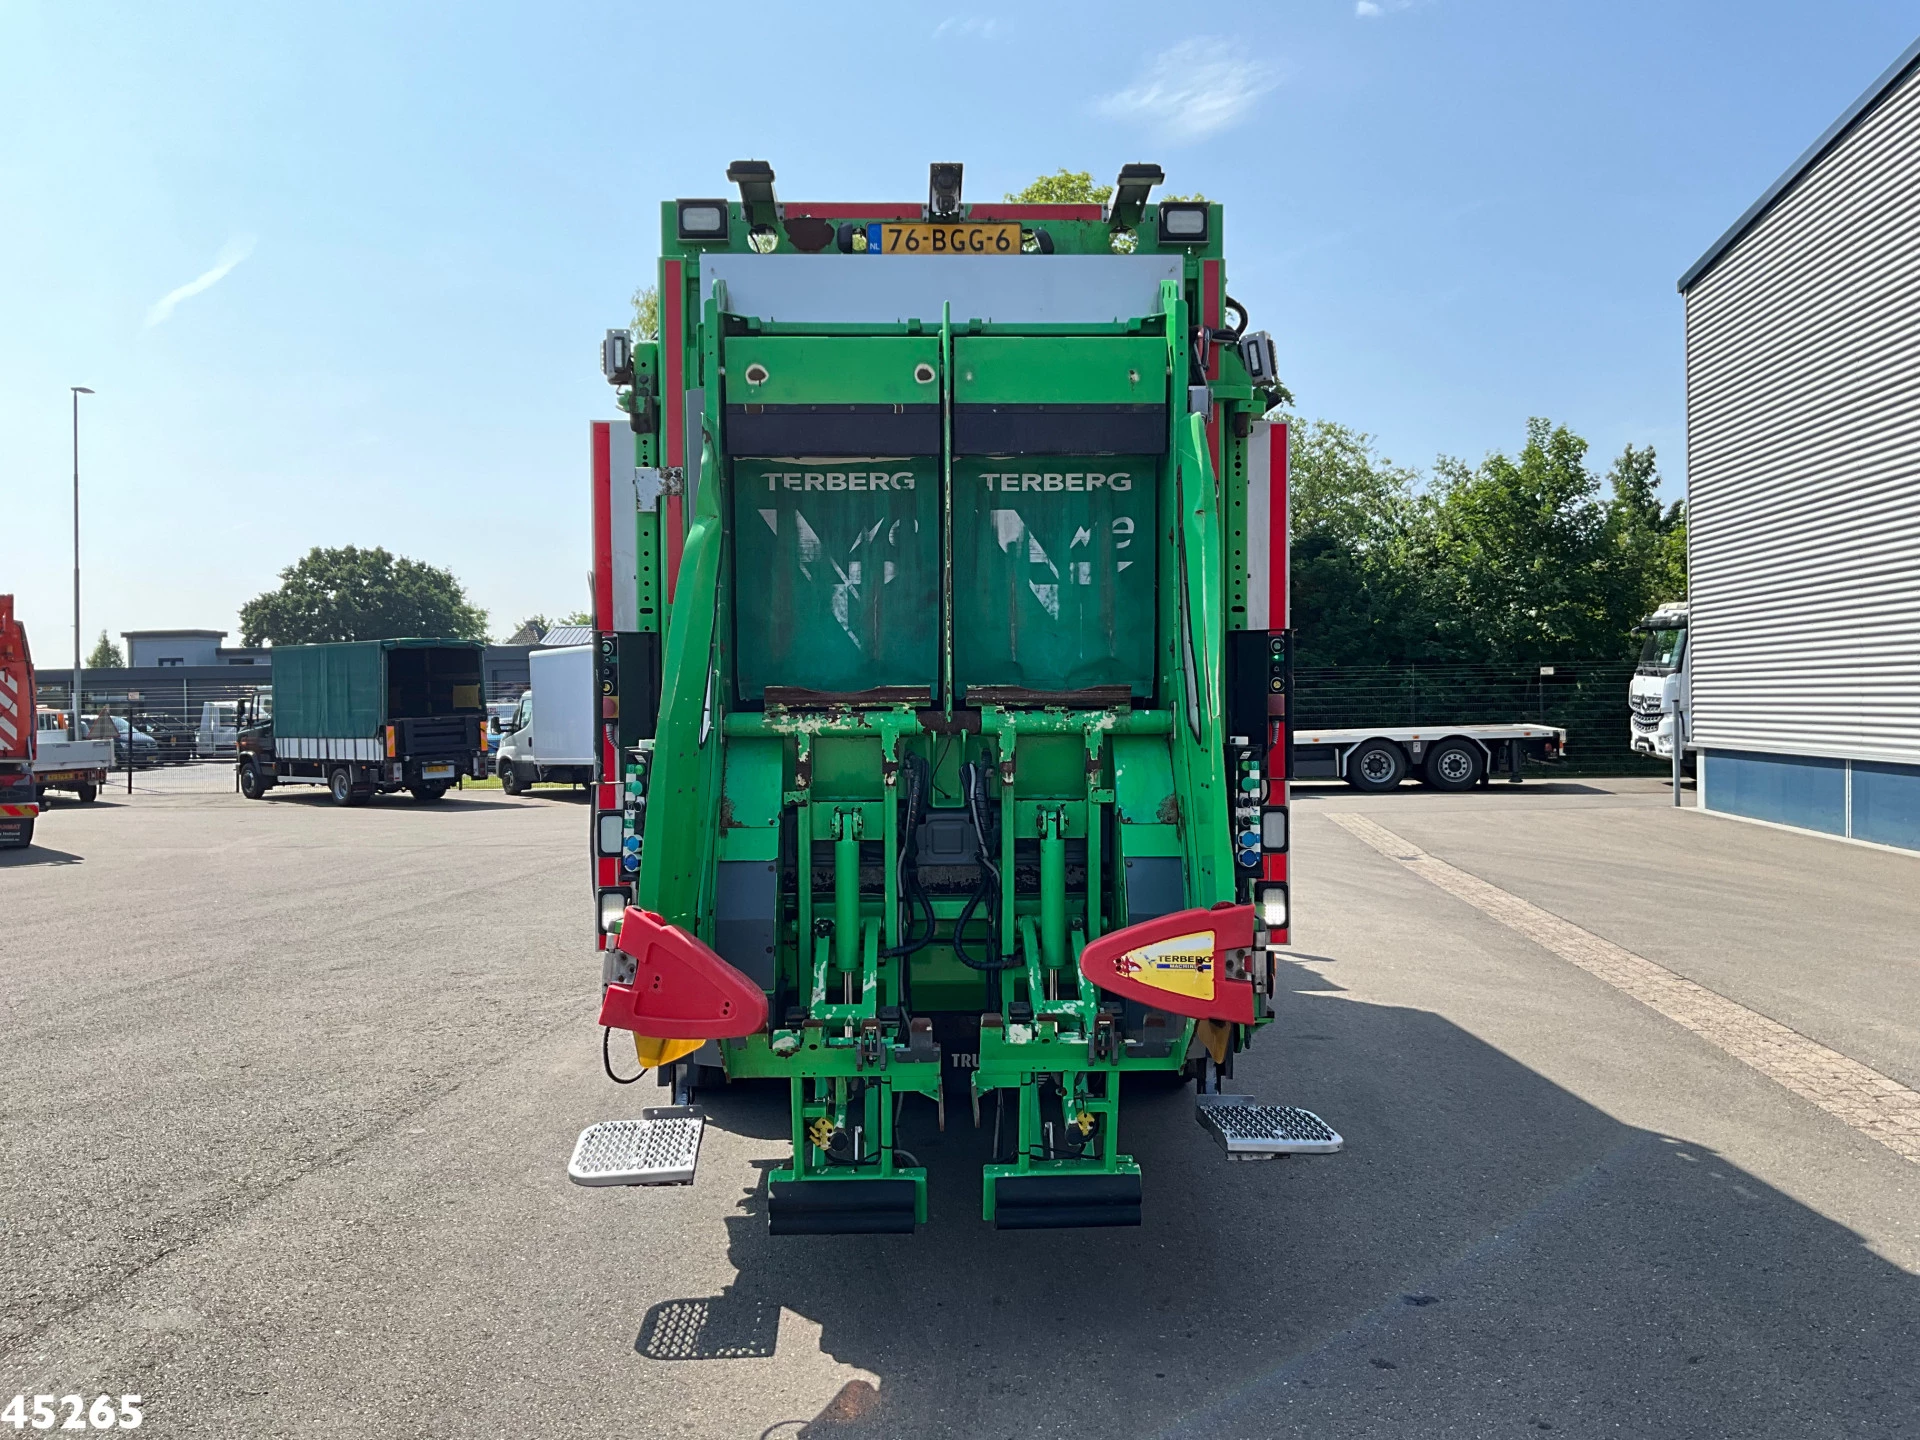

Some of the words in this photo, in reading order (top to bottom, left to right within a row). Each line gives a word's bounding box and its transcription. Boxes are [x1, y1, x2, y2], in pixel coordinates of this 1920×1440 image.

[869, 242, 880, 250] NL
[888, 228, 1011, 251] 76-BGG-6
[760, 472, 915, 491] TERBERG
[978, 472, 1132, 492] TERBERG
[951, 1053, 981, 1068] TRU
